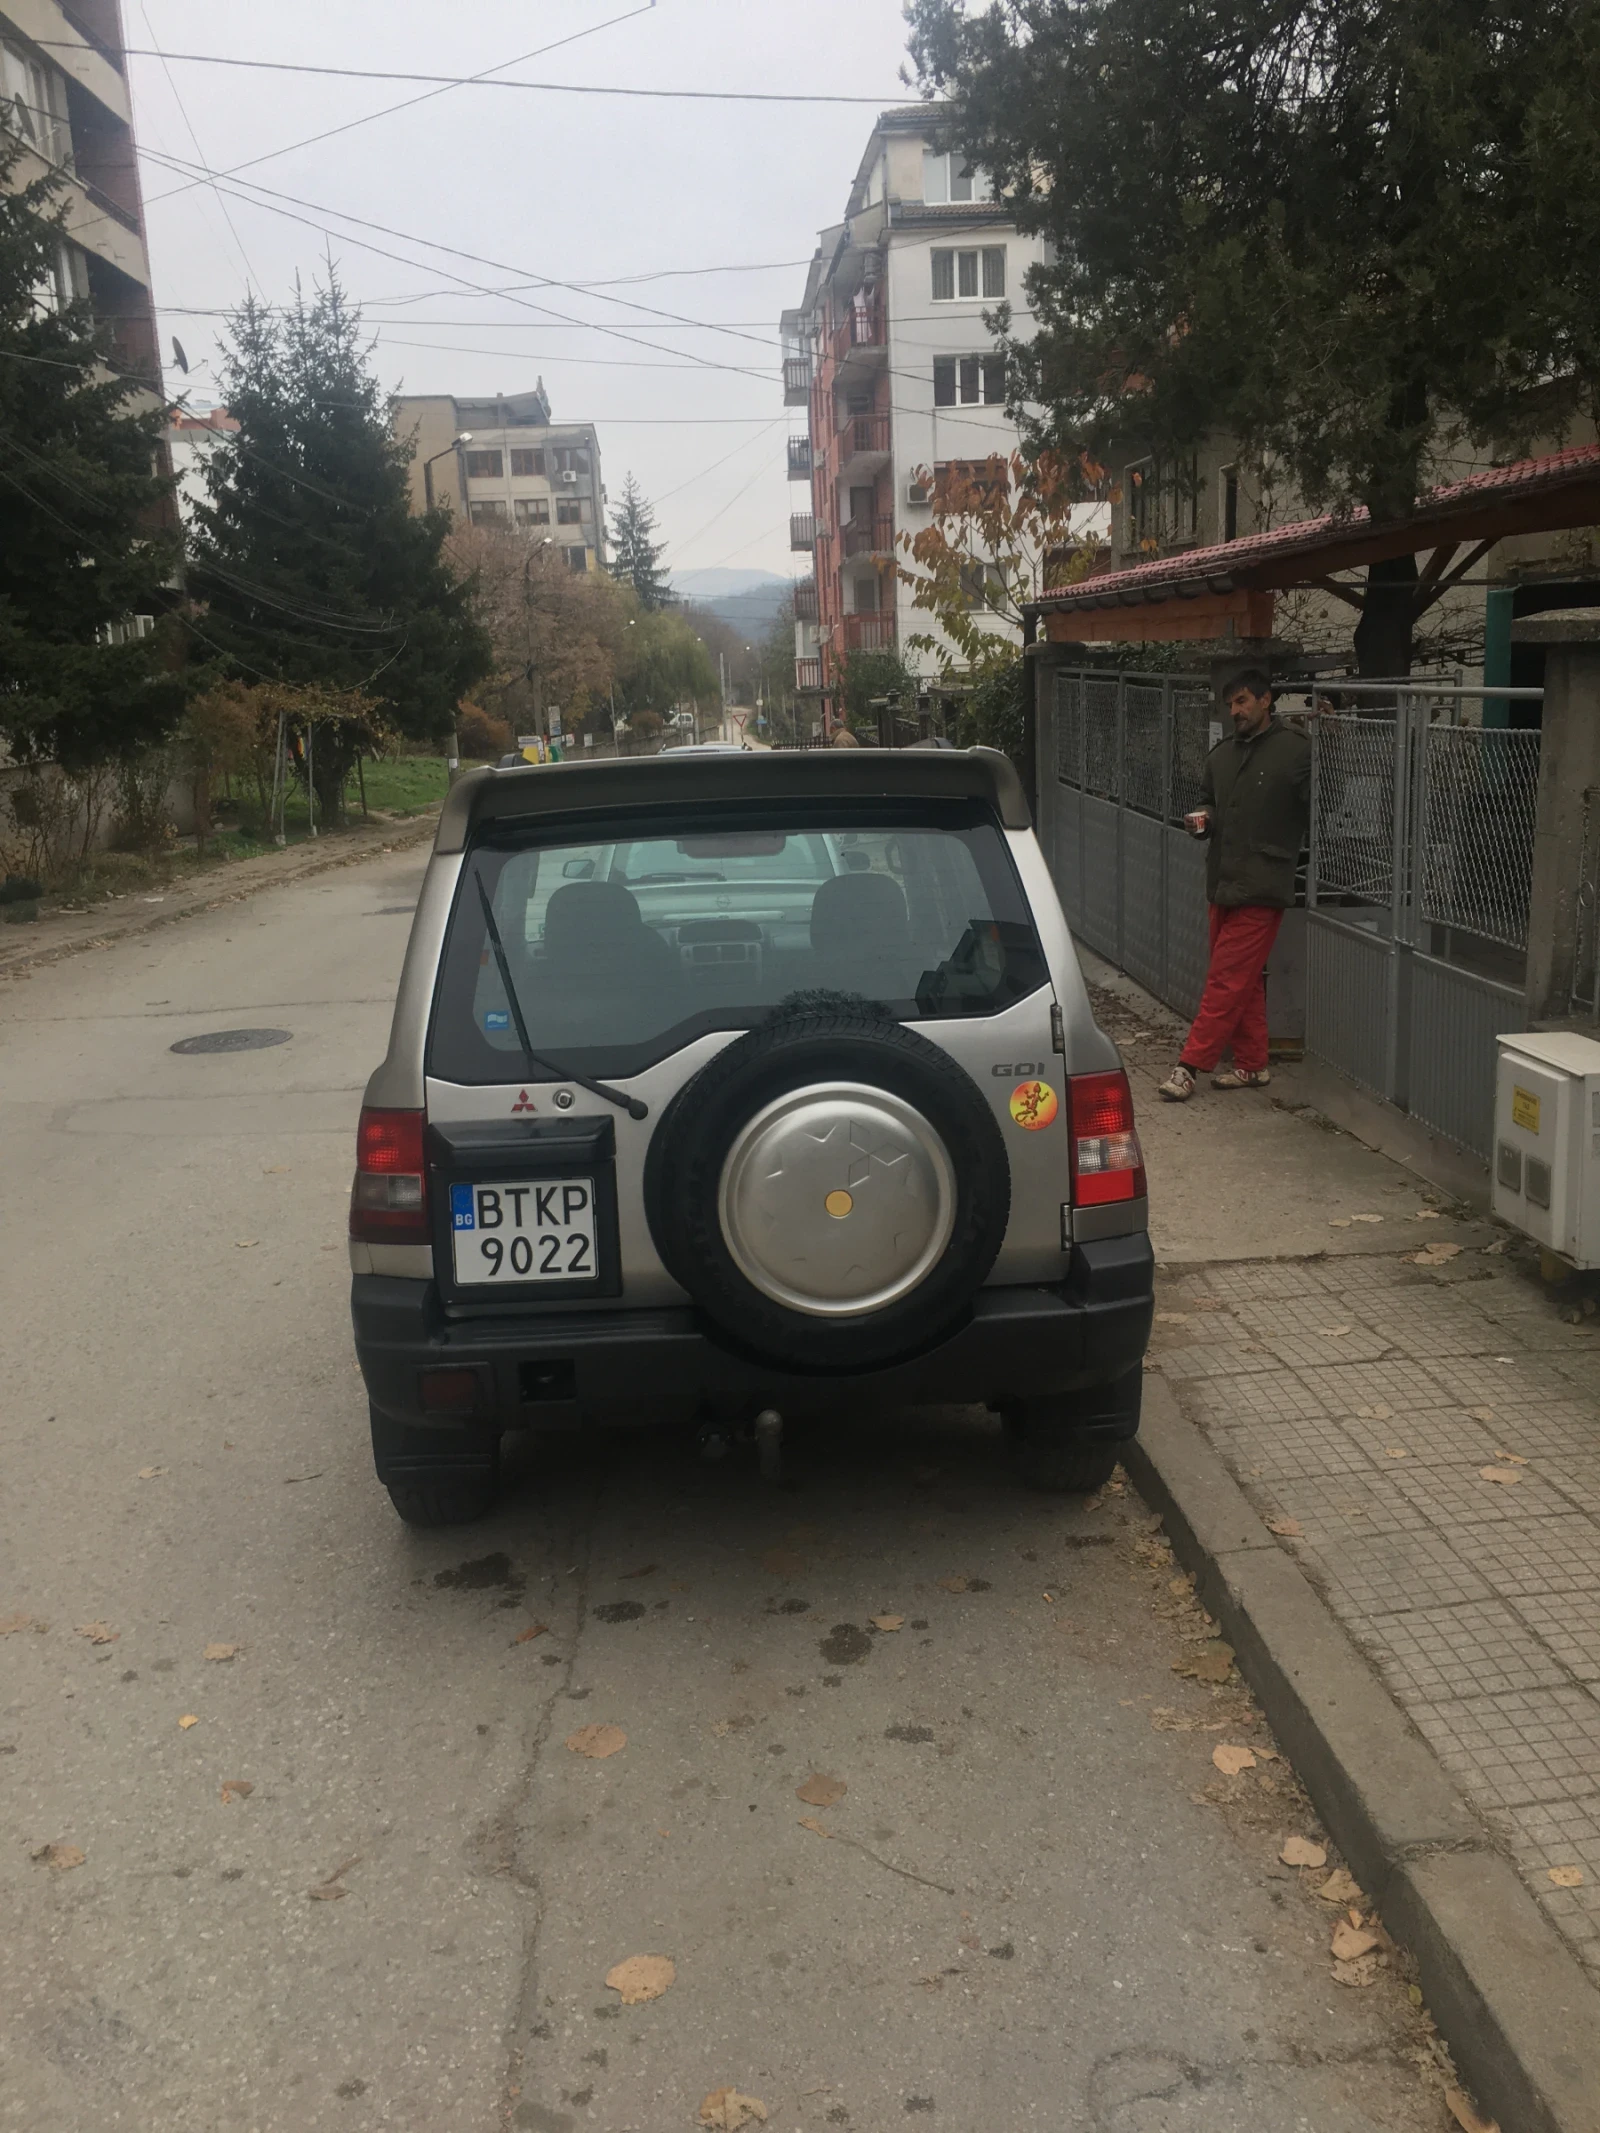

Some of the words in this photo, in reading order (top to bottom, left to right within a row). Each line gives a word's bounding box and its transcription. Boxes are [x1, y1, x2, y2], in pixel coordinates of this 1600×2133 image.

[991, 1062, 1045, 1077] GDI
[455, 1213, 473, 1226] BG
[477, 1185, 588, 1229] BTKP
[481, 1233, 591, 1276] 9022
